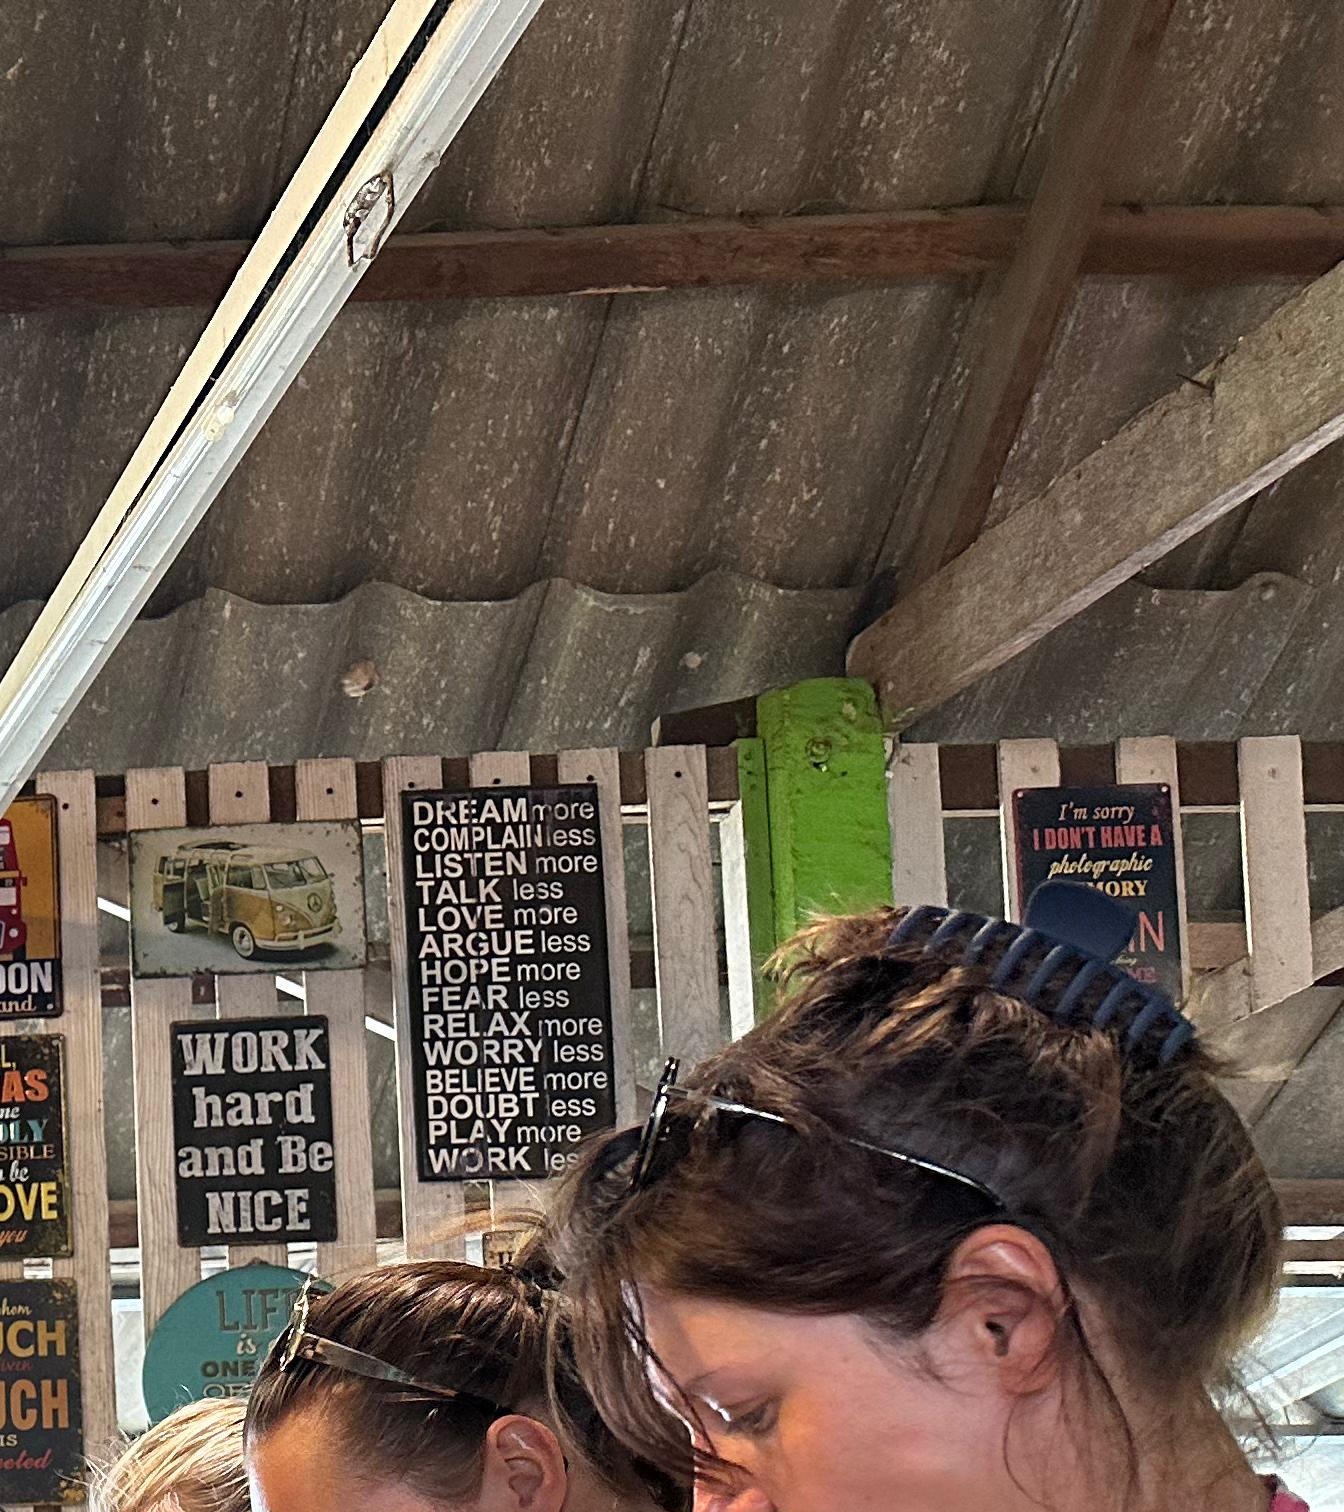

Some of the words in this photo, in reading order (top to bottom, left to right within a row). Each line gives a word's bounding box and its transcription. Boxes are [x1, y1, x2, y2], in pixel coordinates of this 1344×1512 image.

[413, 797, 527, 826] DREAM
[532, 801, 595, 822] more
[1058, 801, 1088, 821] I'm
[1093, 805, 1135, 824] sorry
[414, 824, 543, 852] COMPLAIN
[546, 826, 596, 847] less
[1033, 828, 1040, 850] I
[1044, 826, 1096, 850] DON'T
[1100, 824, 1146, 848] HAVE
[1150, 824, 1163, 846] A
[415, 851, 527, 878] LISTEN
[536, 854, 598, 874] more
[1047, 851, 1153, 880] photographic
[416, 878, 502, 905] TALK
[513, 878, 564, 901] less
[418, 905, 505, 932] LOVE
[514, 906, 578, 926] more
[418, 930, 535, 959] ARGUE
[541, 930, 591, 953] less
[421, 957, 511, 985] HOPE
[517, 962, 581, 981] more
[422, 985, 509, 1012] FEAR
[519, 986, 570, 1009] less
[424, 1011, 532, 1039] RELAX
[538, 1017, 603, 1036] more
[177, 1028, 326, 1076] WORK
[423, 1038, 543, 1066] WORRY
[554, 1040, 604, 1062] less
[425, 1067, 535, 1094] BELIEVE
[544, 1071, 608, 1090] more
[192, 1083, 315, 1128] hard
[427, 1093, 540, 1120] DOUBT
[428, 1118, 512, 1145] PLAY
[517, 1124, 582, 1143] more
[177, 1138, 265, 1178] and
[276, 1135, 334, 1174] Be
[428, 1146, 531, 1174] WORK
[544, 1148, 580, 1171] les
[11, 1160, 29, 1182] be
[205, 1188, 311, 1234] NICE
[237, 1333, 257, 1355] is
[201, 1361, 255, 1377] ONE
[0, 1434, 18, 1447] IS
